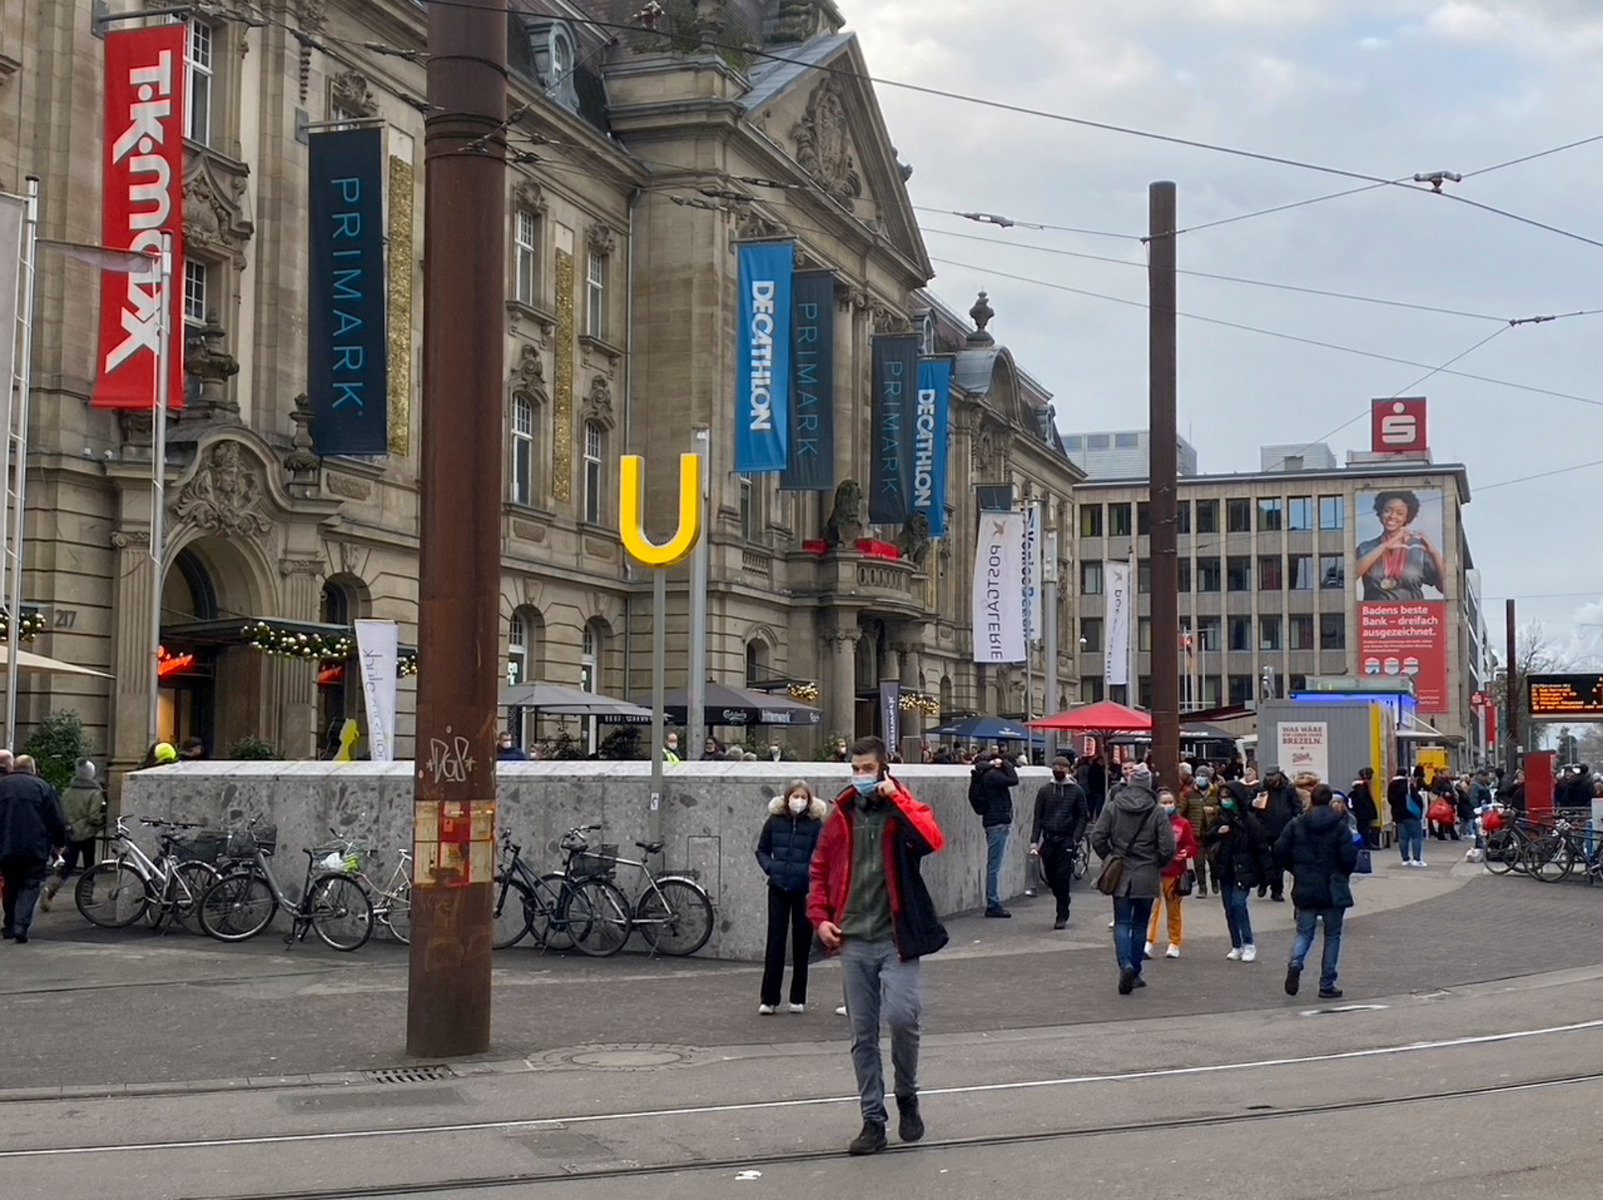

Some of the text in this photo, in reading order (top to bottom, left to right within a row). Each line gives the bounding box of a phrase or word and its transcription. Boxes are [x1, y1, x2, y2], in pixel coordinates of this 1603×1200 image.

[330, 177, 365, 409] PRIMARK
[750, 280, 775, 430] DECATHLON
[796, 302, 818, 456] PRIMARK
[881, 360, 903, 494] PRIMARK
[914, 388, 935, 507] DECATHLON
[620, 453, 702, 567] U
[56, 610, 77, 628] 217
[1362, 605, 1428, 615] Badens beste
[1362, 617, 1387, 626] Bank
[1398, 616, 1438, 625] dreifach
[1362, 627, 1436, 638] ausgezeichnet.
[1282, 737, 1323, 745] BREZELN.
